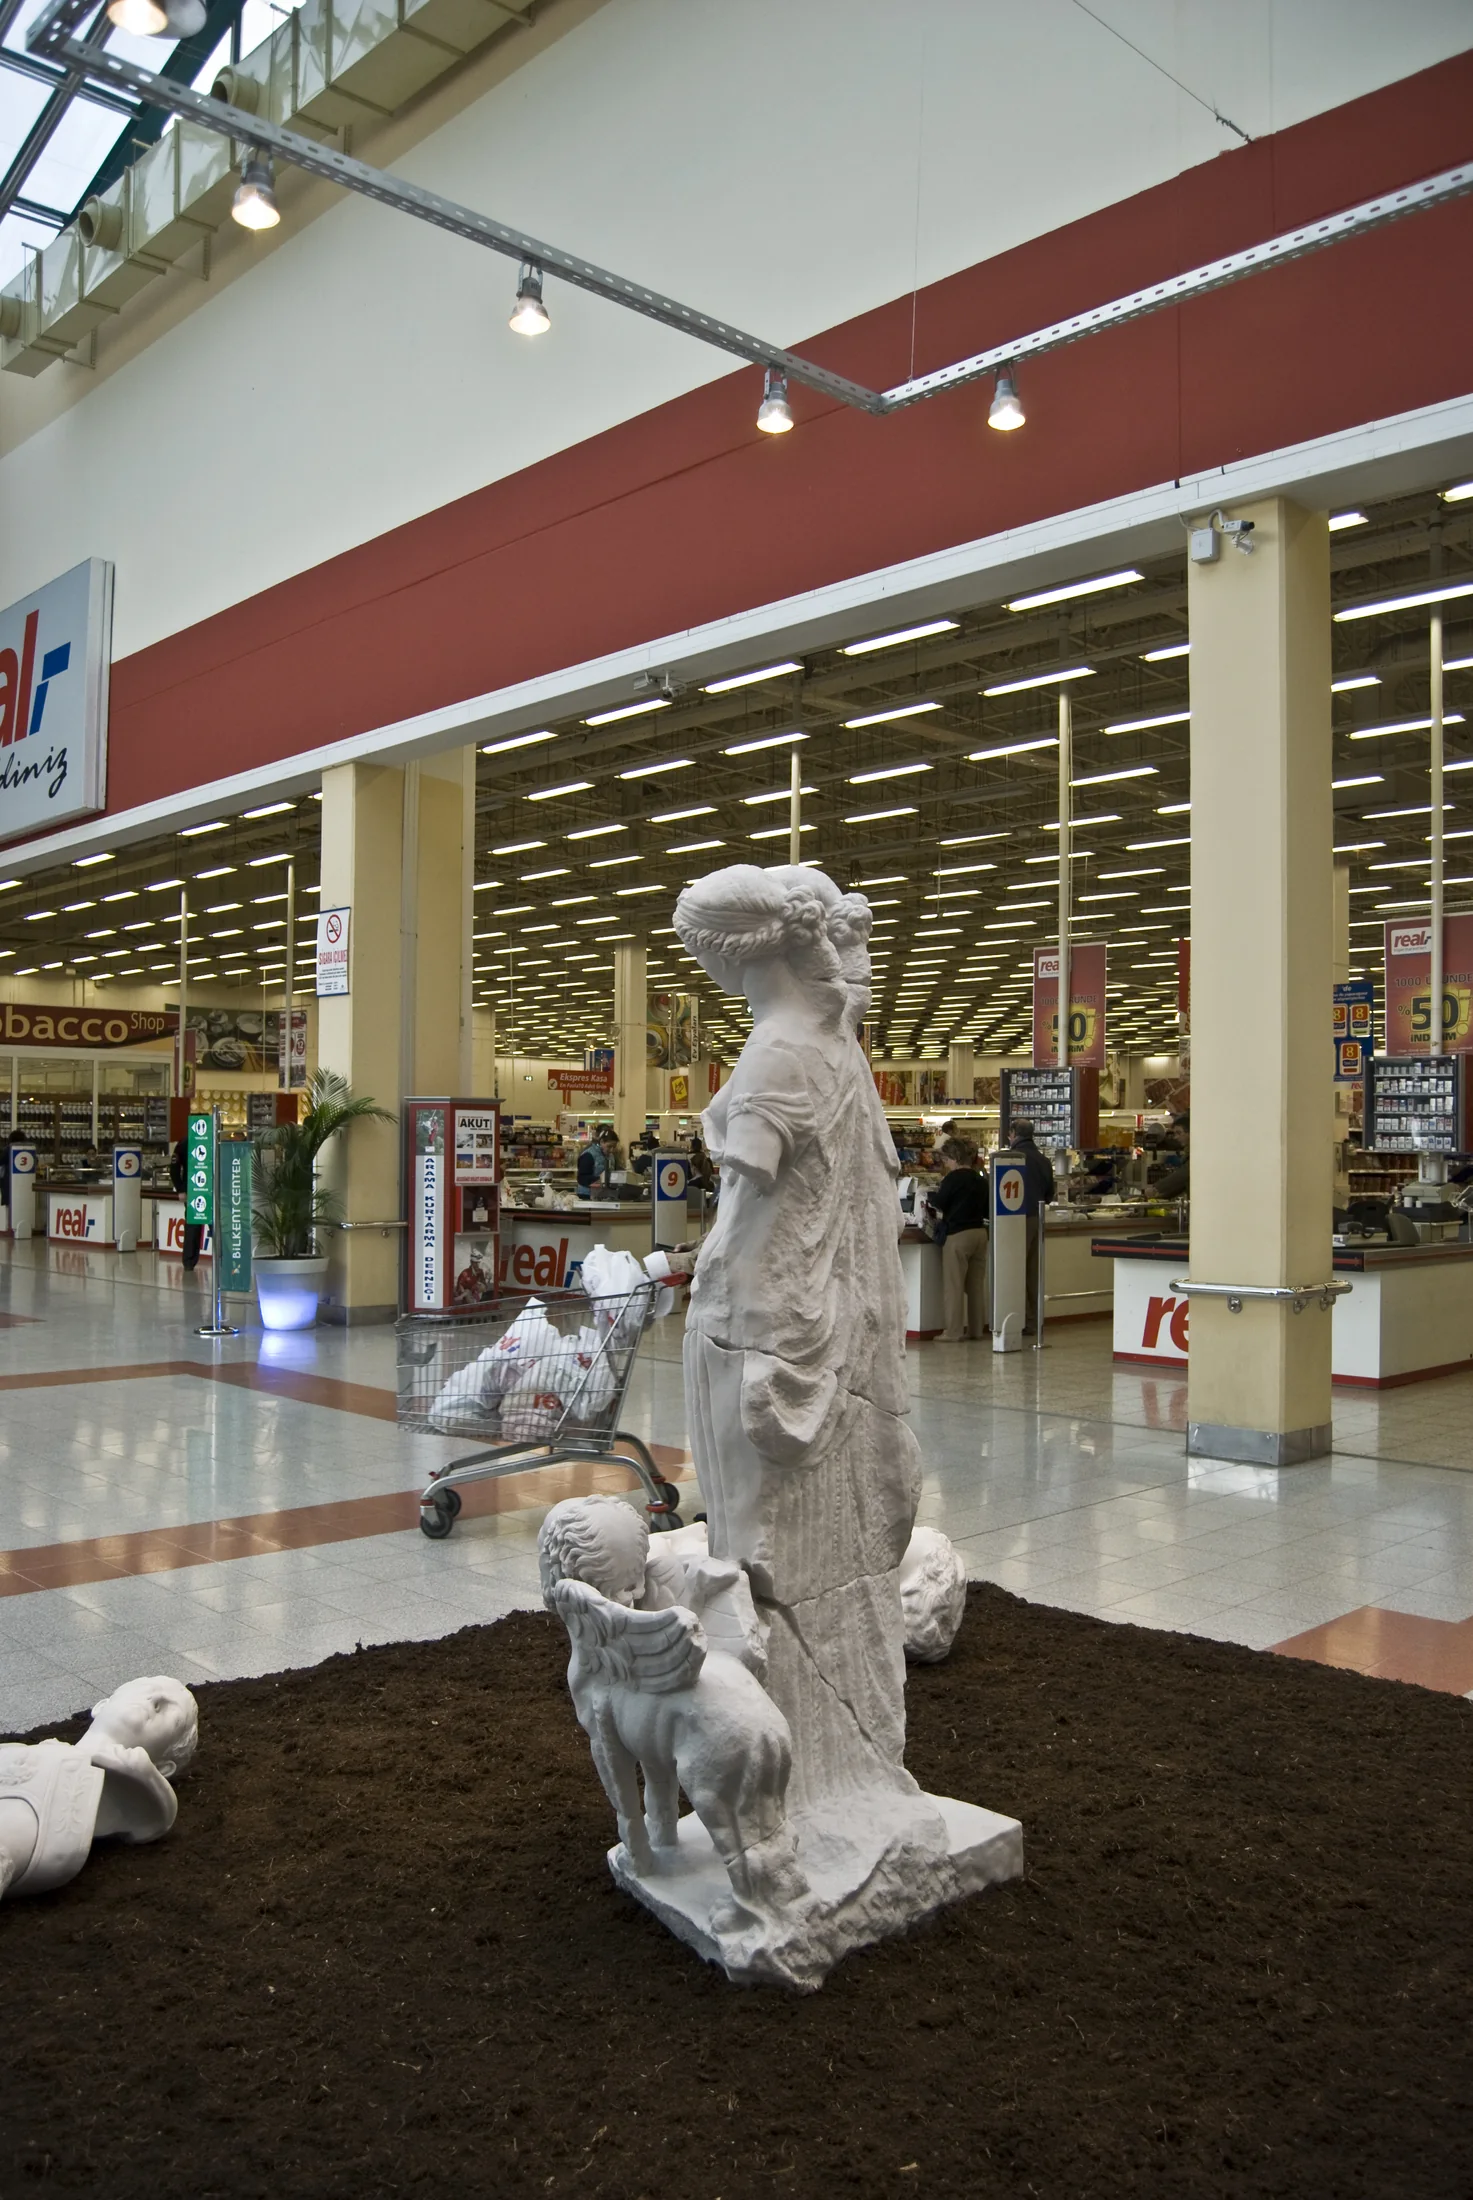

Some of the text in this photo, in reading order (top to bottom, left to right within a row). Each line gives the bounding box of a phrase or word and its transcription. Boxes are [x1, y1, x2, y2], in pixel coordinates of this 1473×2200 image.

[1356, 1007, 1364, 1019] 8
[0, 1005, 164, 1043] bacco Shop
[1346, 1046, 1355, 1057] 8
[560, 1073, 608, 1082] Ekspres Kasa
[460, 1118, 490, 1128] AKUT
[20, 1156, 28, 1166] 3
[124, 1159, 132, 1170] 5
[424, 1158, 436, 1189] ARAMA
[667, 1171, 678, 1187] 9
[232, 1158, 241, 1205] CENTER
[1003, 1180, 1019, 1199] 11
[424, 1196, 436, 1247] KURTARMA
